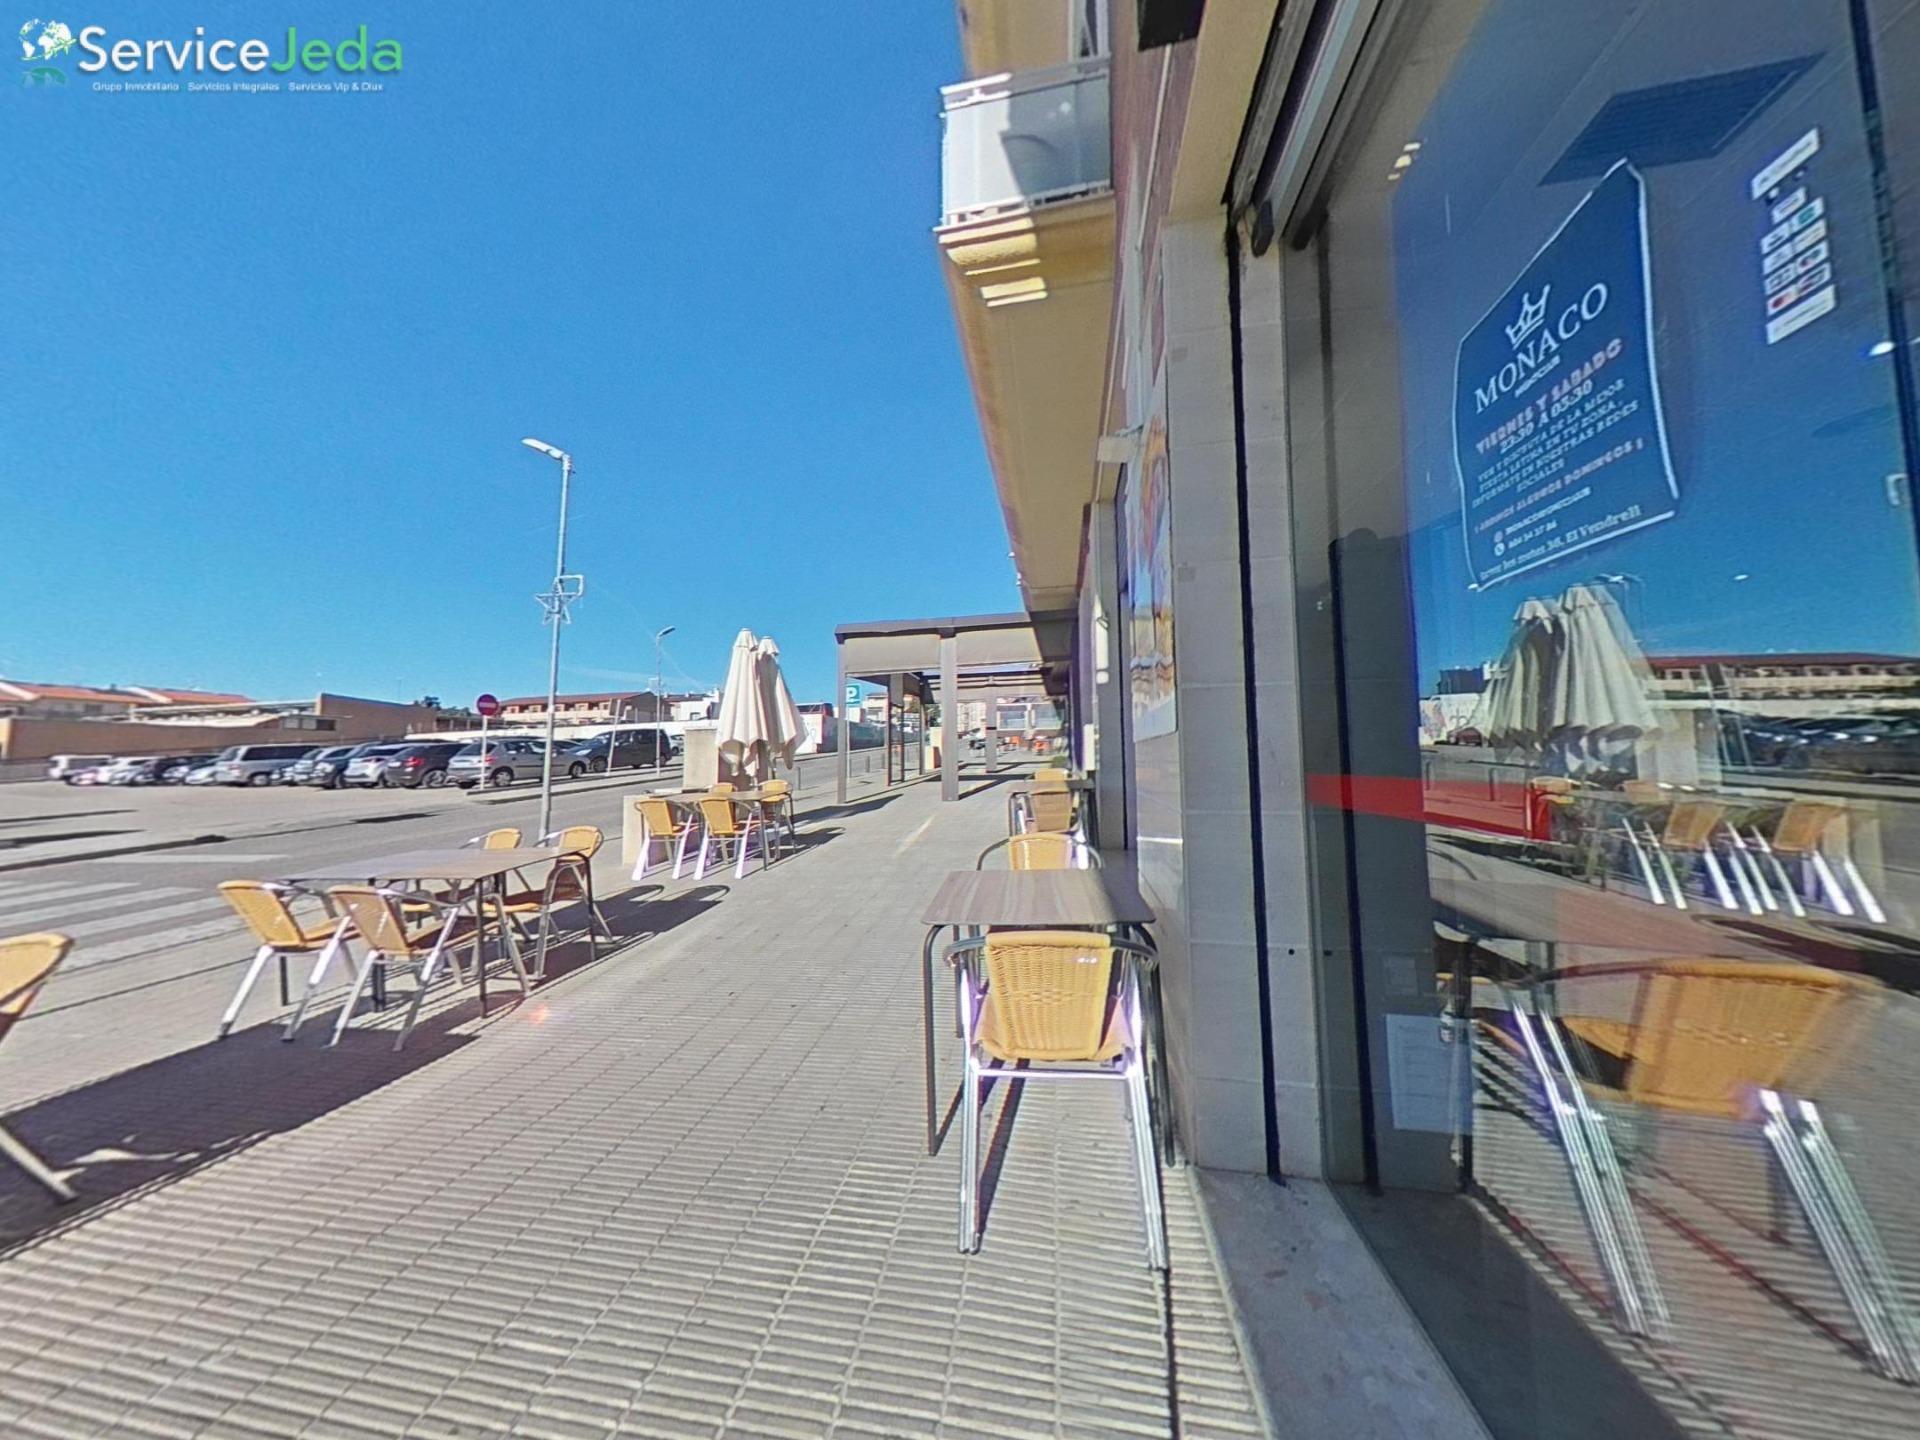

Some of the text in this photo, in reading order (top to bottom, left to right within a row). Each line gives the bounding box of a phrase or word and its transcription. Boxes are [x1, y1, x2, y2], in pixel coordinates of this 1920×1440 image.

[1474, 282, 1608, 414] MONACO
[1475, 405, 1534, 454] VIERNES
[1536, 394, 1548, 411] Y
[1551, 337, 1623, 401] SABADO
[1538, 411, 1549, 428] A
[1550, 418, 1565, 435] DE
[1567, 408, 1581, 425] LA
[1597, 400, 1638, 433] REDES
[1579, 503, 1642, 537] Vendrell
